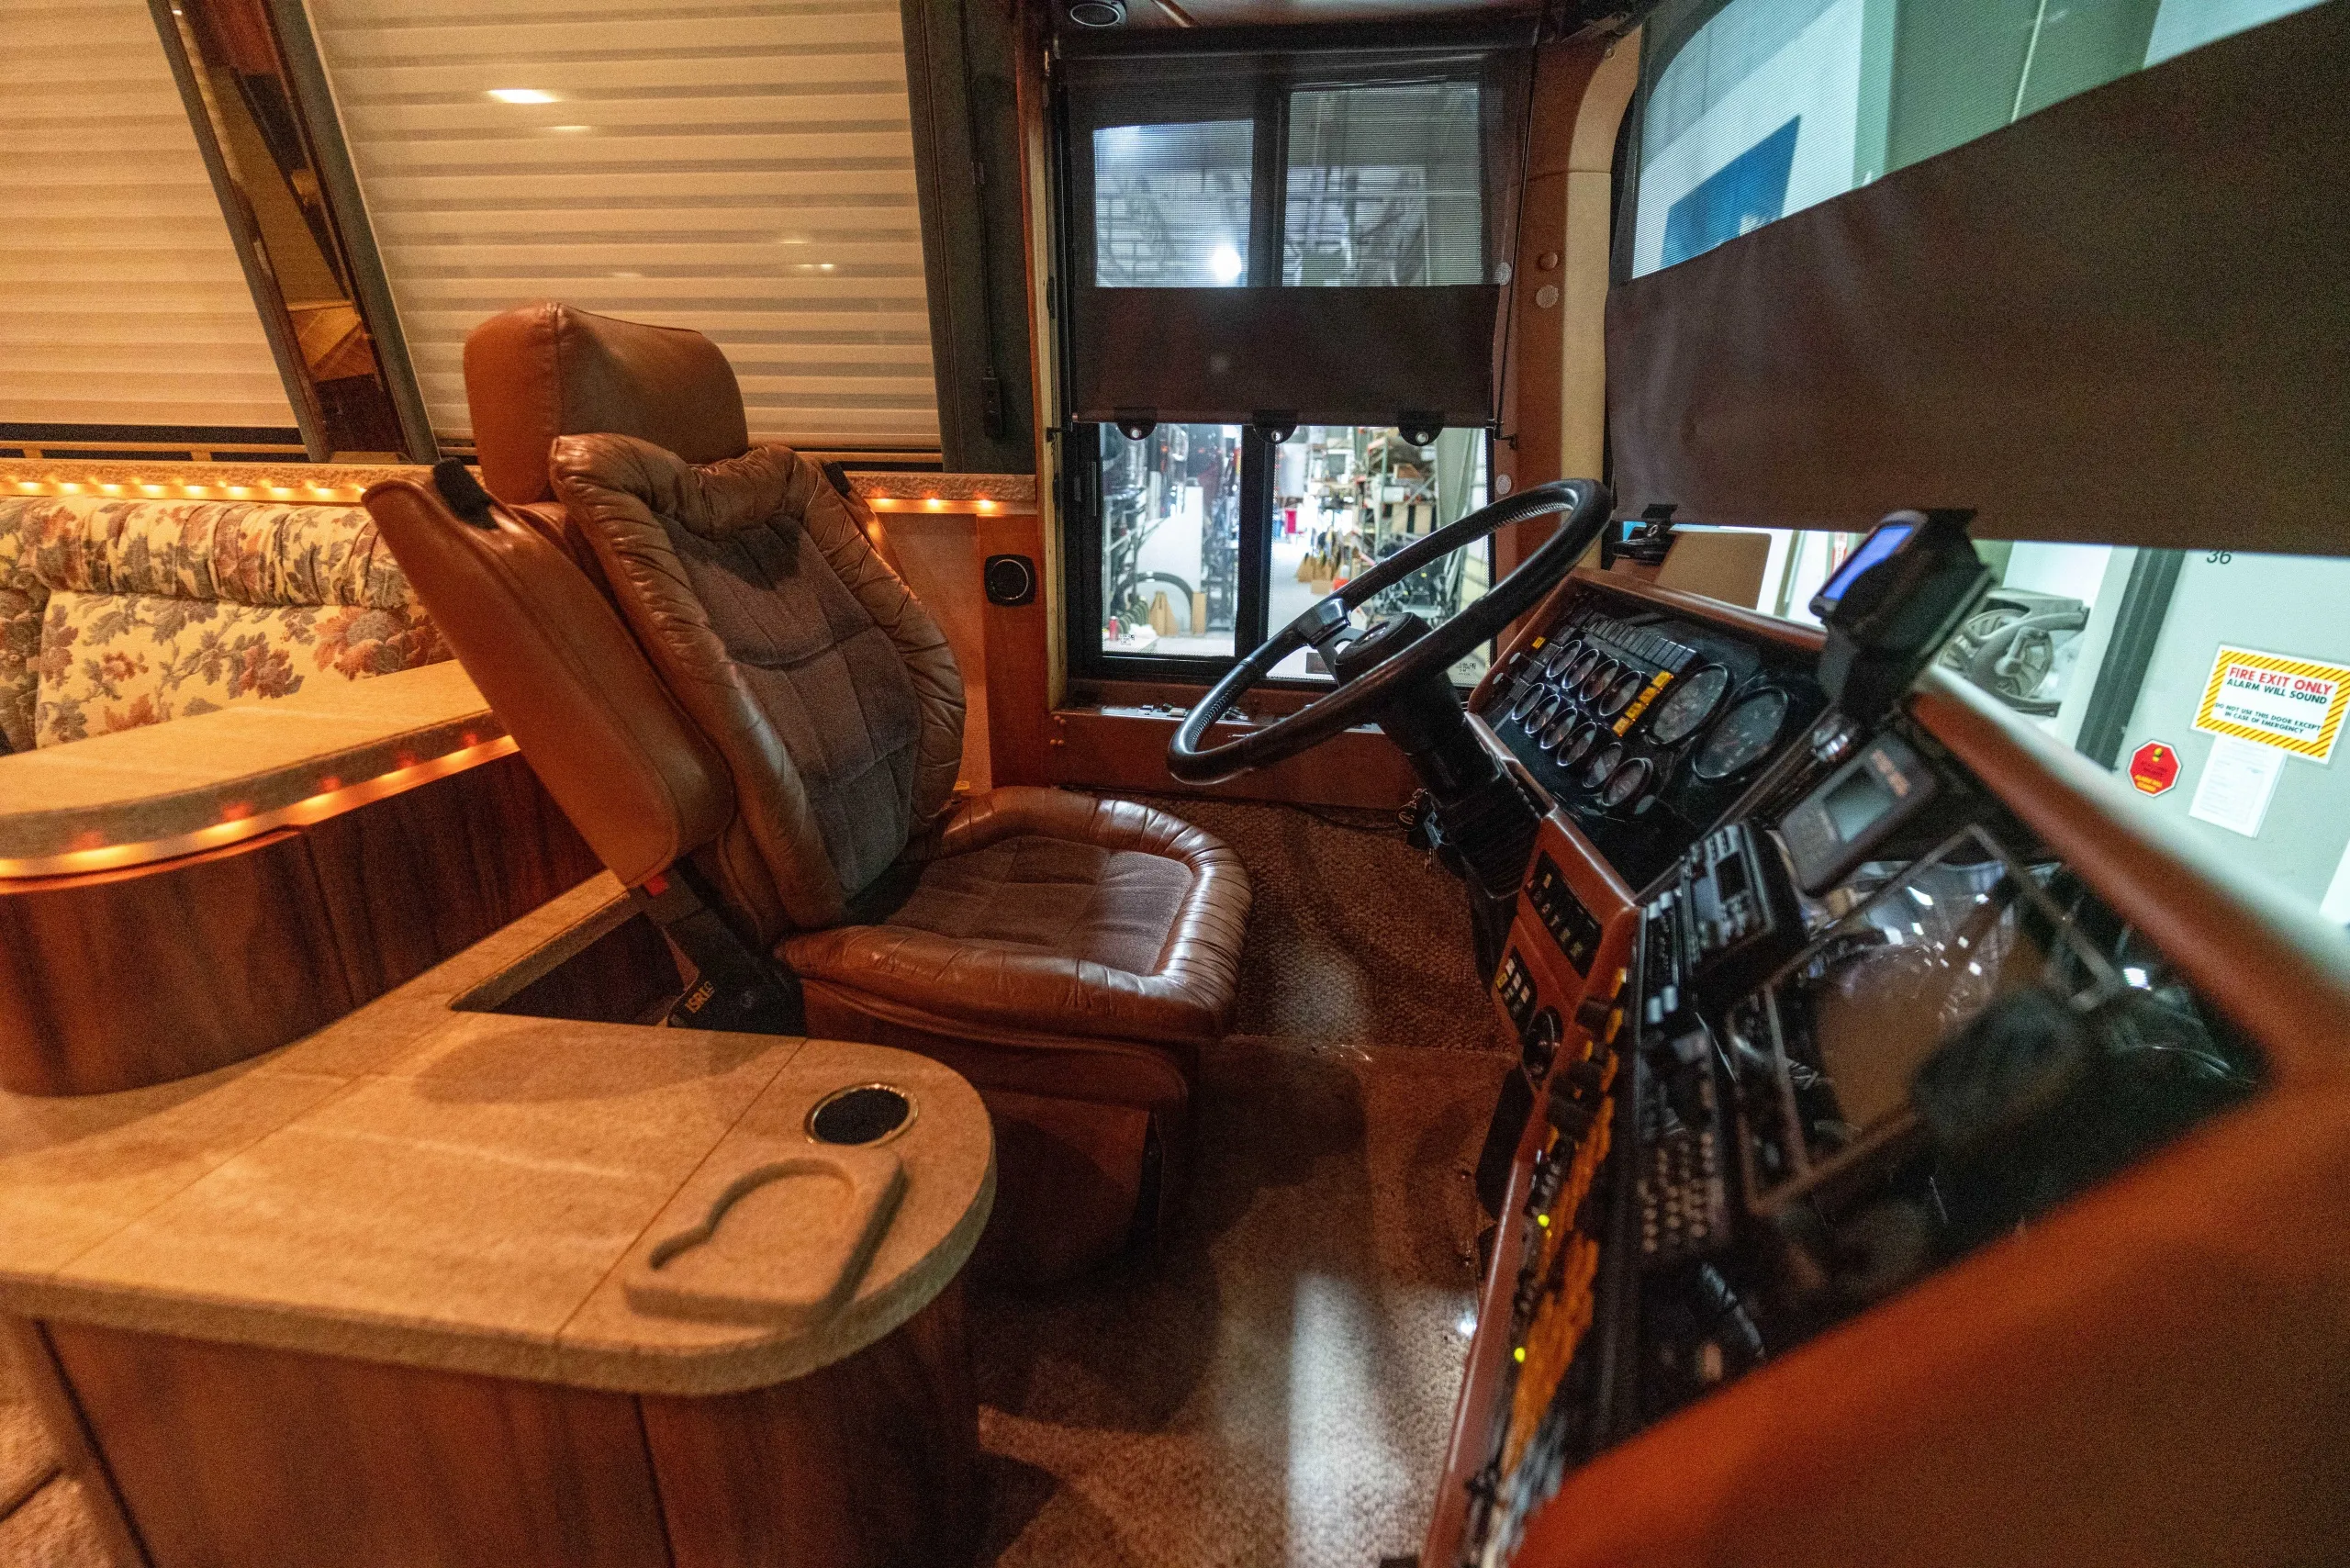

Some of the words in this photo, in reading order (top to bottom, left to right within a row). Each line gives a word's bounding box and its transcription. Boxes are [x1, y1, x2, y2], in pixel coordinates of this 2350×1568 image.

[2227, 679, 2259, 690] ALARM
[2264, 686, 2286, 696] WILL
[2289, 690, 2327, 704] SOUND
[2230, 667, 2255, 680] FIRE
[2259, 673, 2290, 687] EXIT
[2294, 680, 2333, 695] ONLY
[2255, 711, 2269, 719] THIS
[2271, 714, 2292, 723] DOOR
[2294, 720, 2321, 731] EXCEPT
[2261, 720, 2304, 734] EMERGENCY
